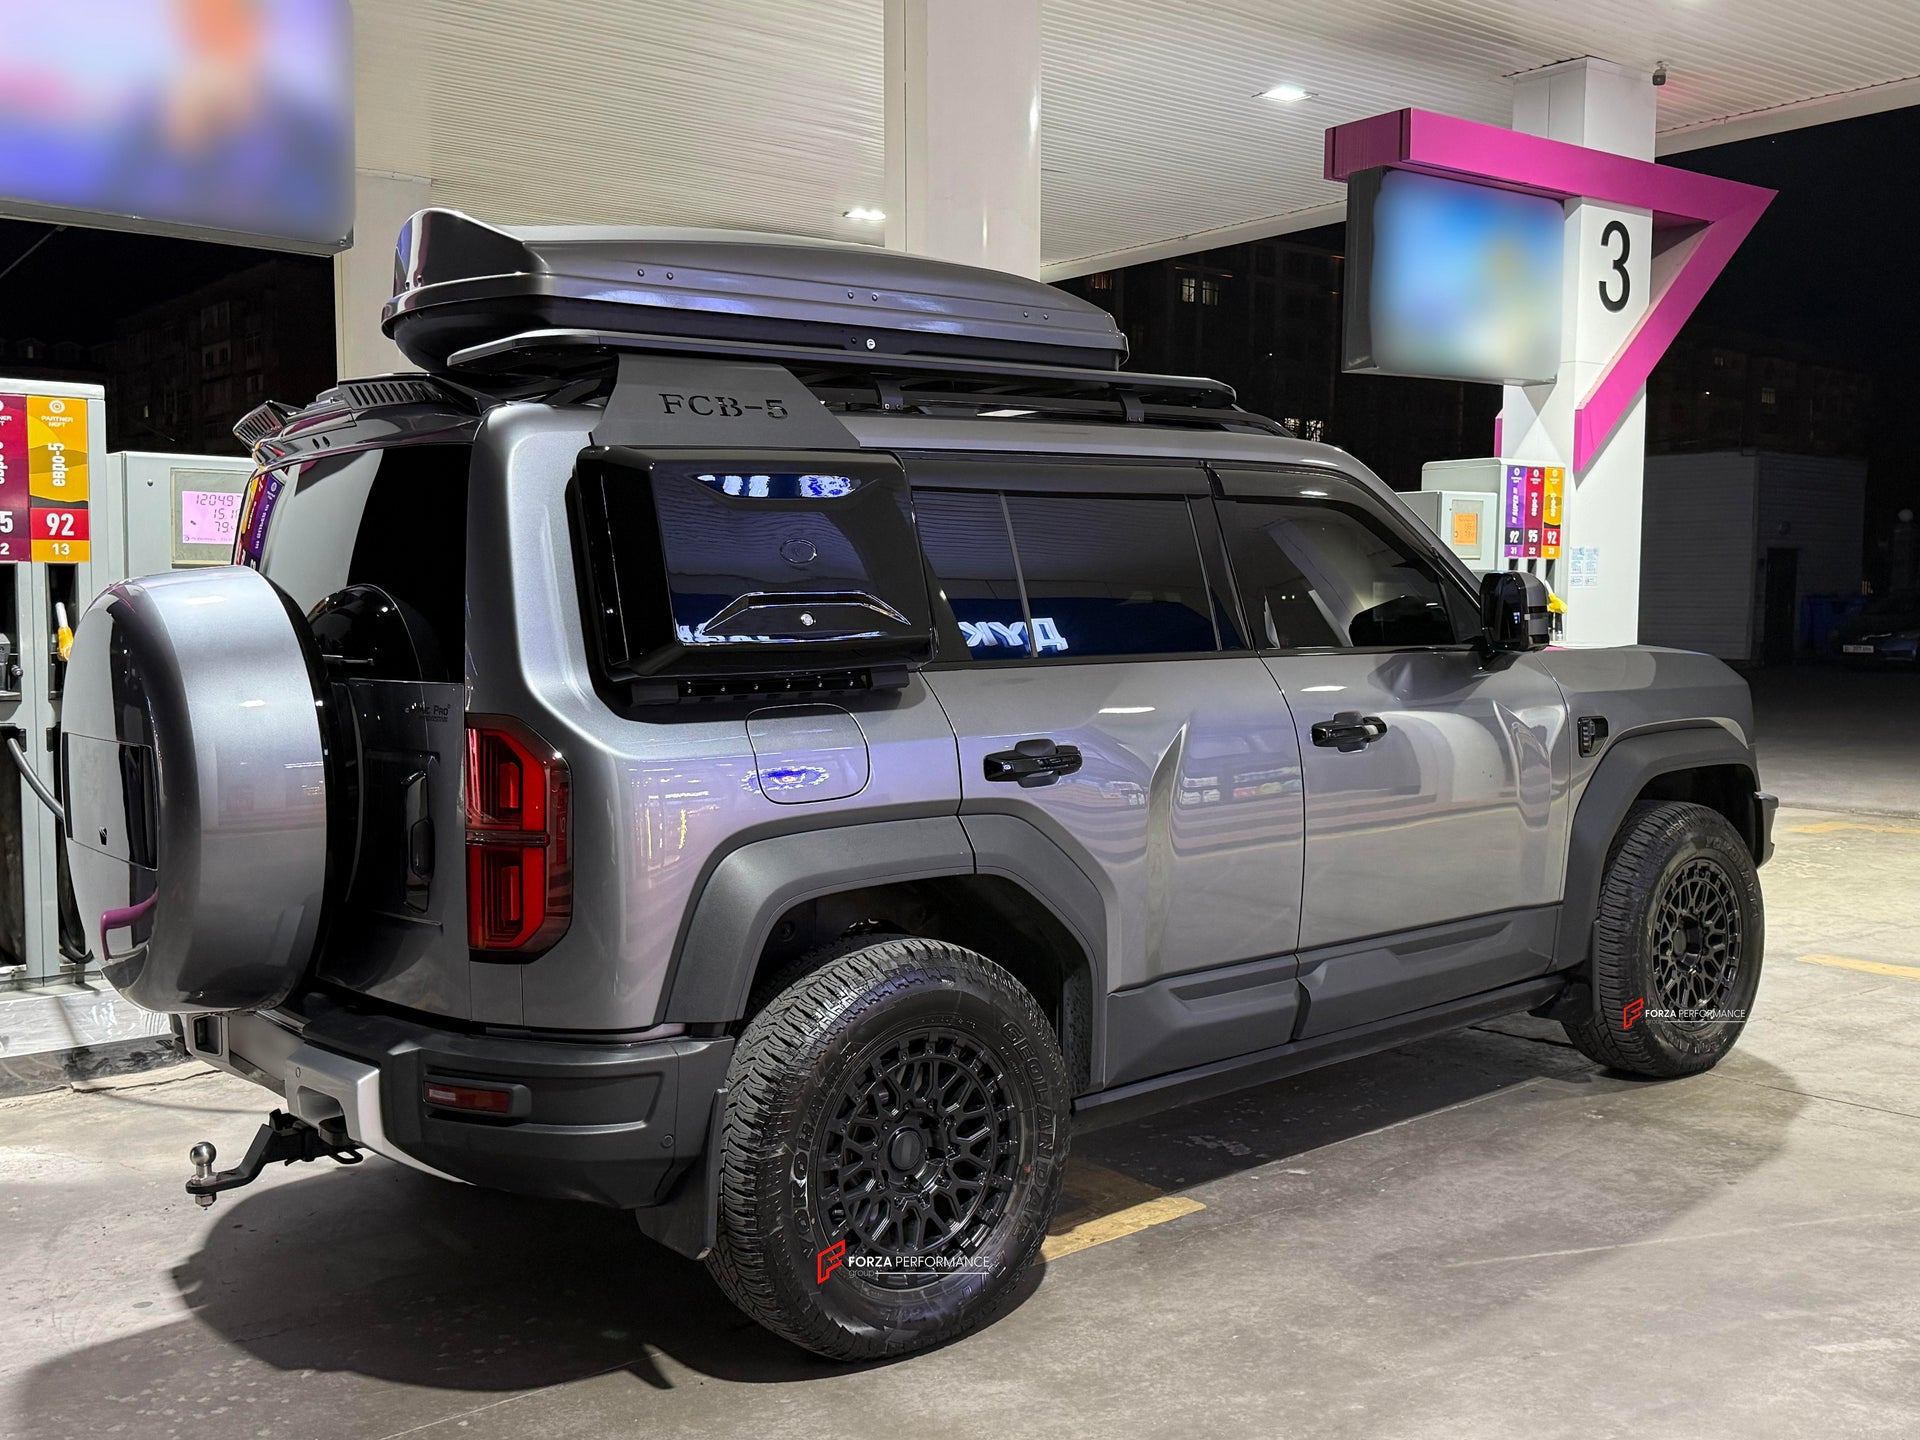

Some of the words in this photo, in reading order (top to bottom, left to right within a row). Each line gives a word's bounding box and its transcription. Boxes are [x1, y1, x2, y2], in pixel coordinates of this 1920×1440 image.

[1598, 220, 1631, 314] 3
[658, 392, 789, 421] FCB-5
[47, 442, 70, 487] евро-5
[46, 512, 75, 537] 92
[1509, 530, 1520, 543] 92
[1528, 529, 1539, 543] 95
[1547, 531, 1557, 544] 92
[52, 543, 70, 556] 13
